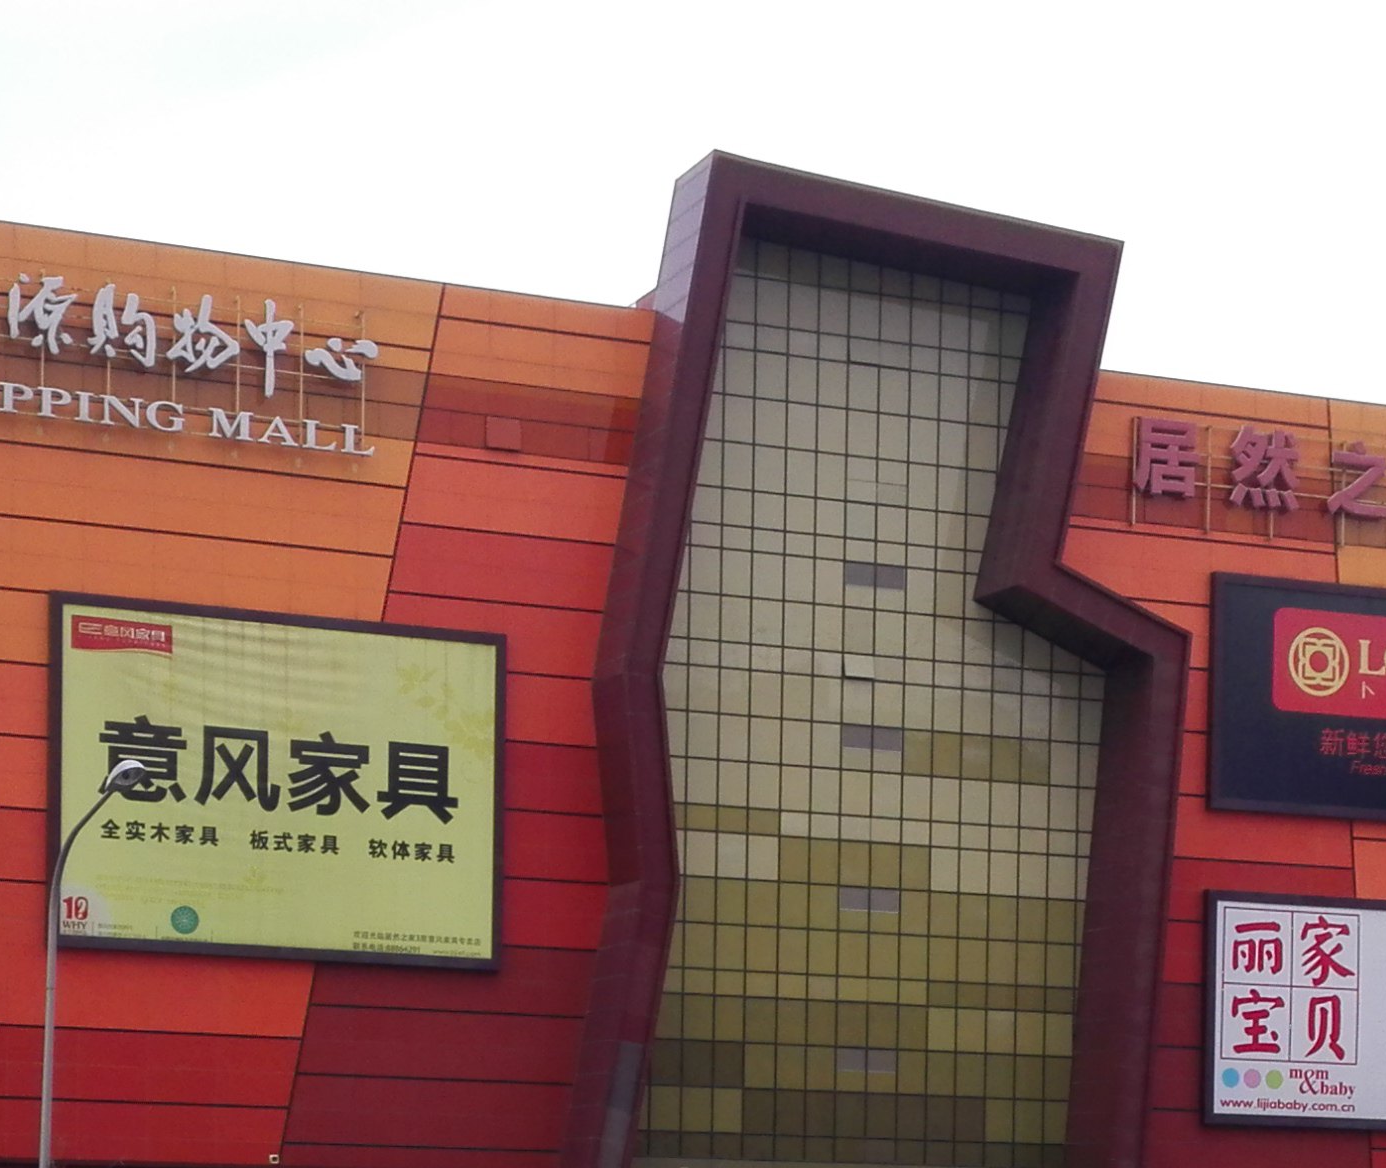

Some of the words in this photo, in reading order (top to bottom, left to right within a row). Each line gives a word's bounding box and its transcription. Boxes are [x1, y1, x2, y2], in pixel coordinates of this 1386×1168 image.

[208, 406, 375, 457] MALL
[98, 715, 459, 824] 意风家具
[100, 819, 220, 847] 全实木家具
[249, 830, 341, 855] 板式家具
[368, 838, 456, 863] 软体家具
[1220, 1098, 1355, 1114] www.lijiababy.com.cn
